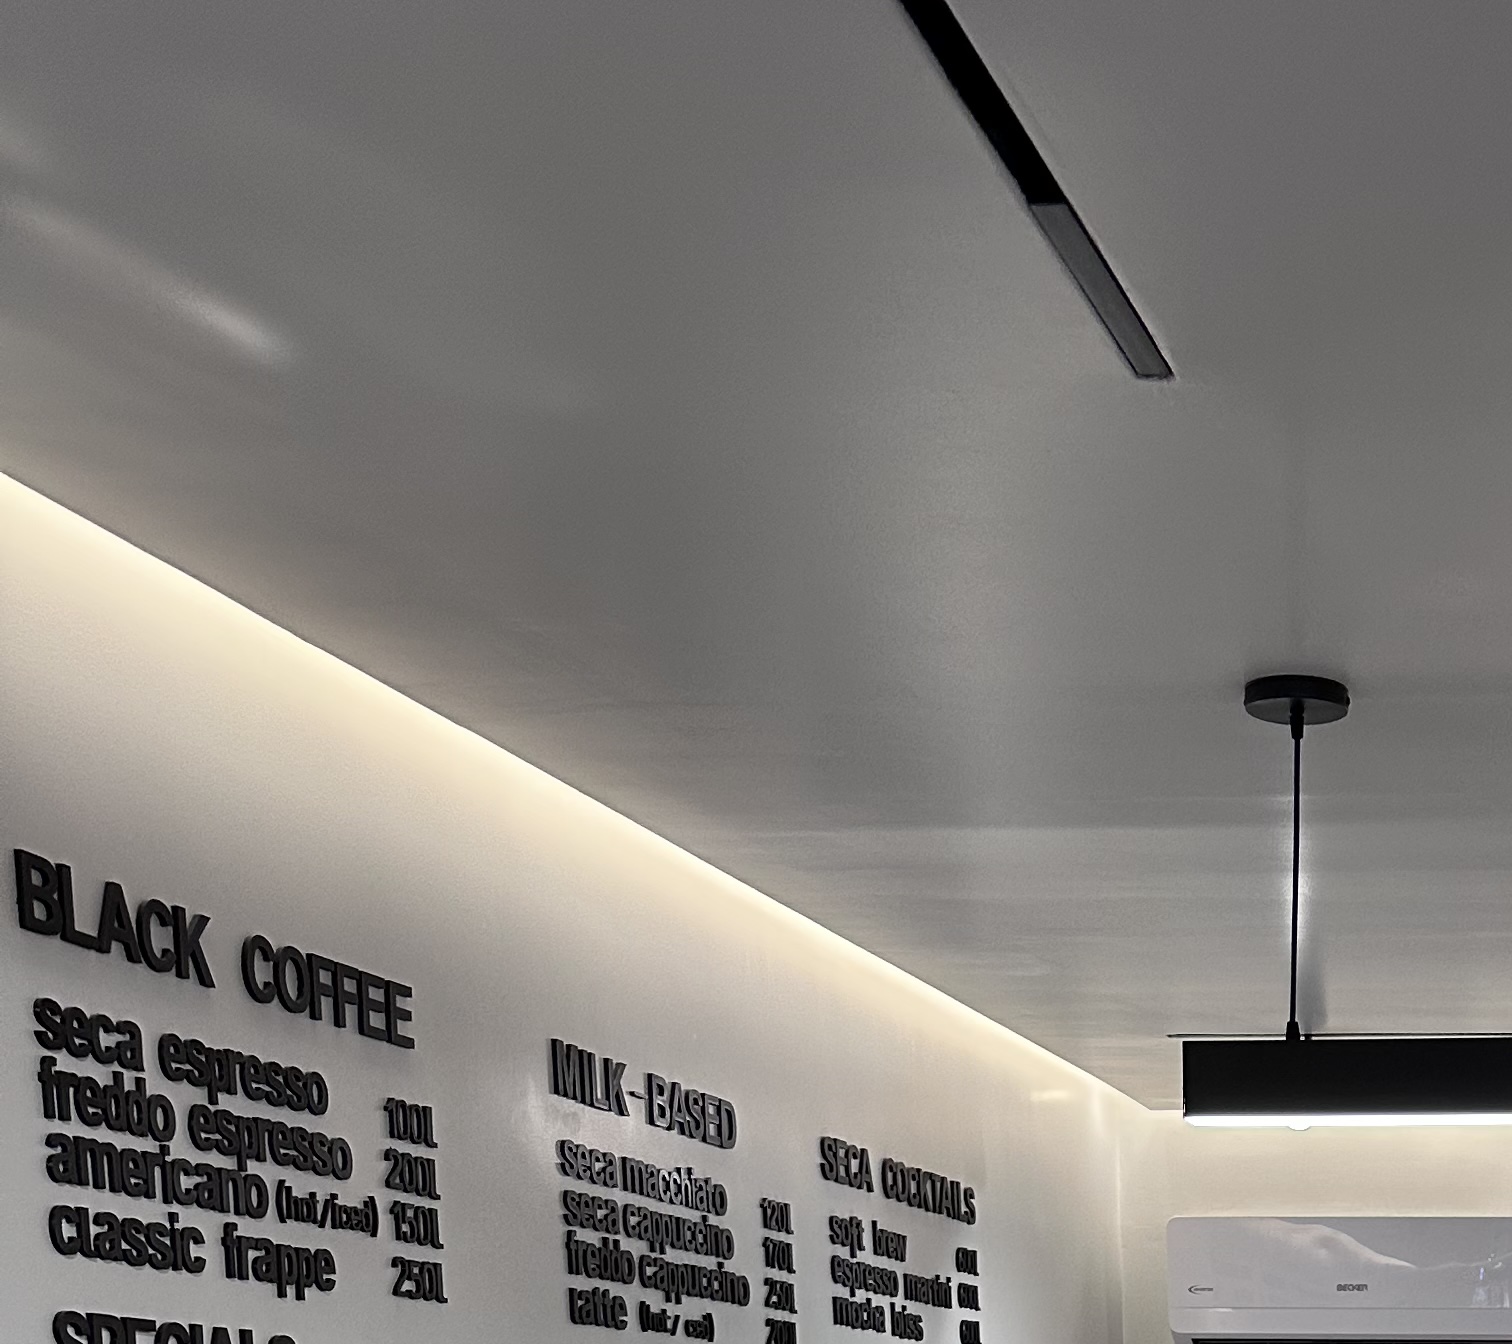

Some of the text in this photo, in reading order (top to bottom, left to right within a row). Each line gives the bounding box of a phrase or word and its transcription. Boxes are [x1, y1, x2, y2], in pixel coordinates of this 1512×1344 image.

[14, 849, 414, 1049] BLACK COFFEE
[33, 998, 144, 1072] seca
[158, 1033, 328, 1115] espresso
[38, 1056, 176, 1142] freddo
[188, 1103, 353, 1180] espresso
[45, 1132, 269, 1218] americano
[555, 1139, 619, 1188] seca
[619, 1157, 727, 1216] macchiato
[820, 1136, 976, 1226] SECA COCKTAILS
[49, 1205, 206, 1274] classic
[221, 1222, 336, 1300] frappe
[563, 1190, 620, 1235] seca
[622, 1203, 734, 1260] cappuccino
[829, 1215, 866, 1258] soft
[871, 1220, 907, 1262] brew
[565, 1230, 635, 1284] freddo
[639, 1254, 750, 1306] cappuccino
[831, 1255, 899, 1298] espresso
[903, 1273, 953, 1309] martini
[568, 1287, 628, 1330] latte
[832, 1296, 886, 1333] mocha
